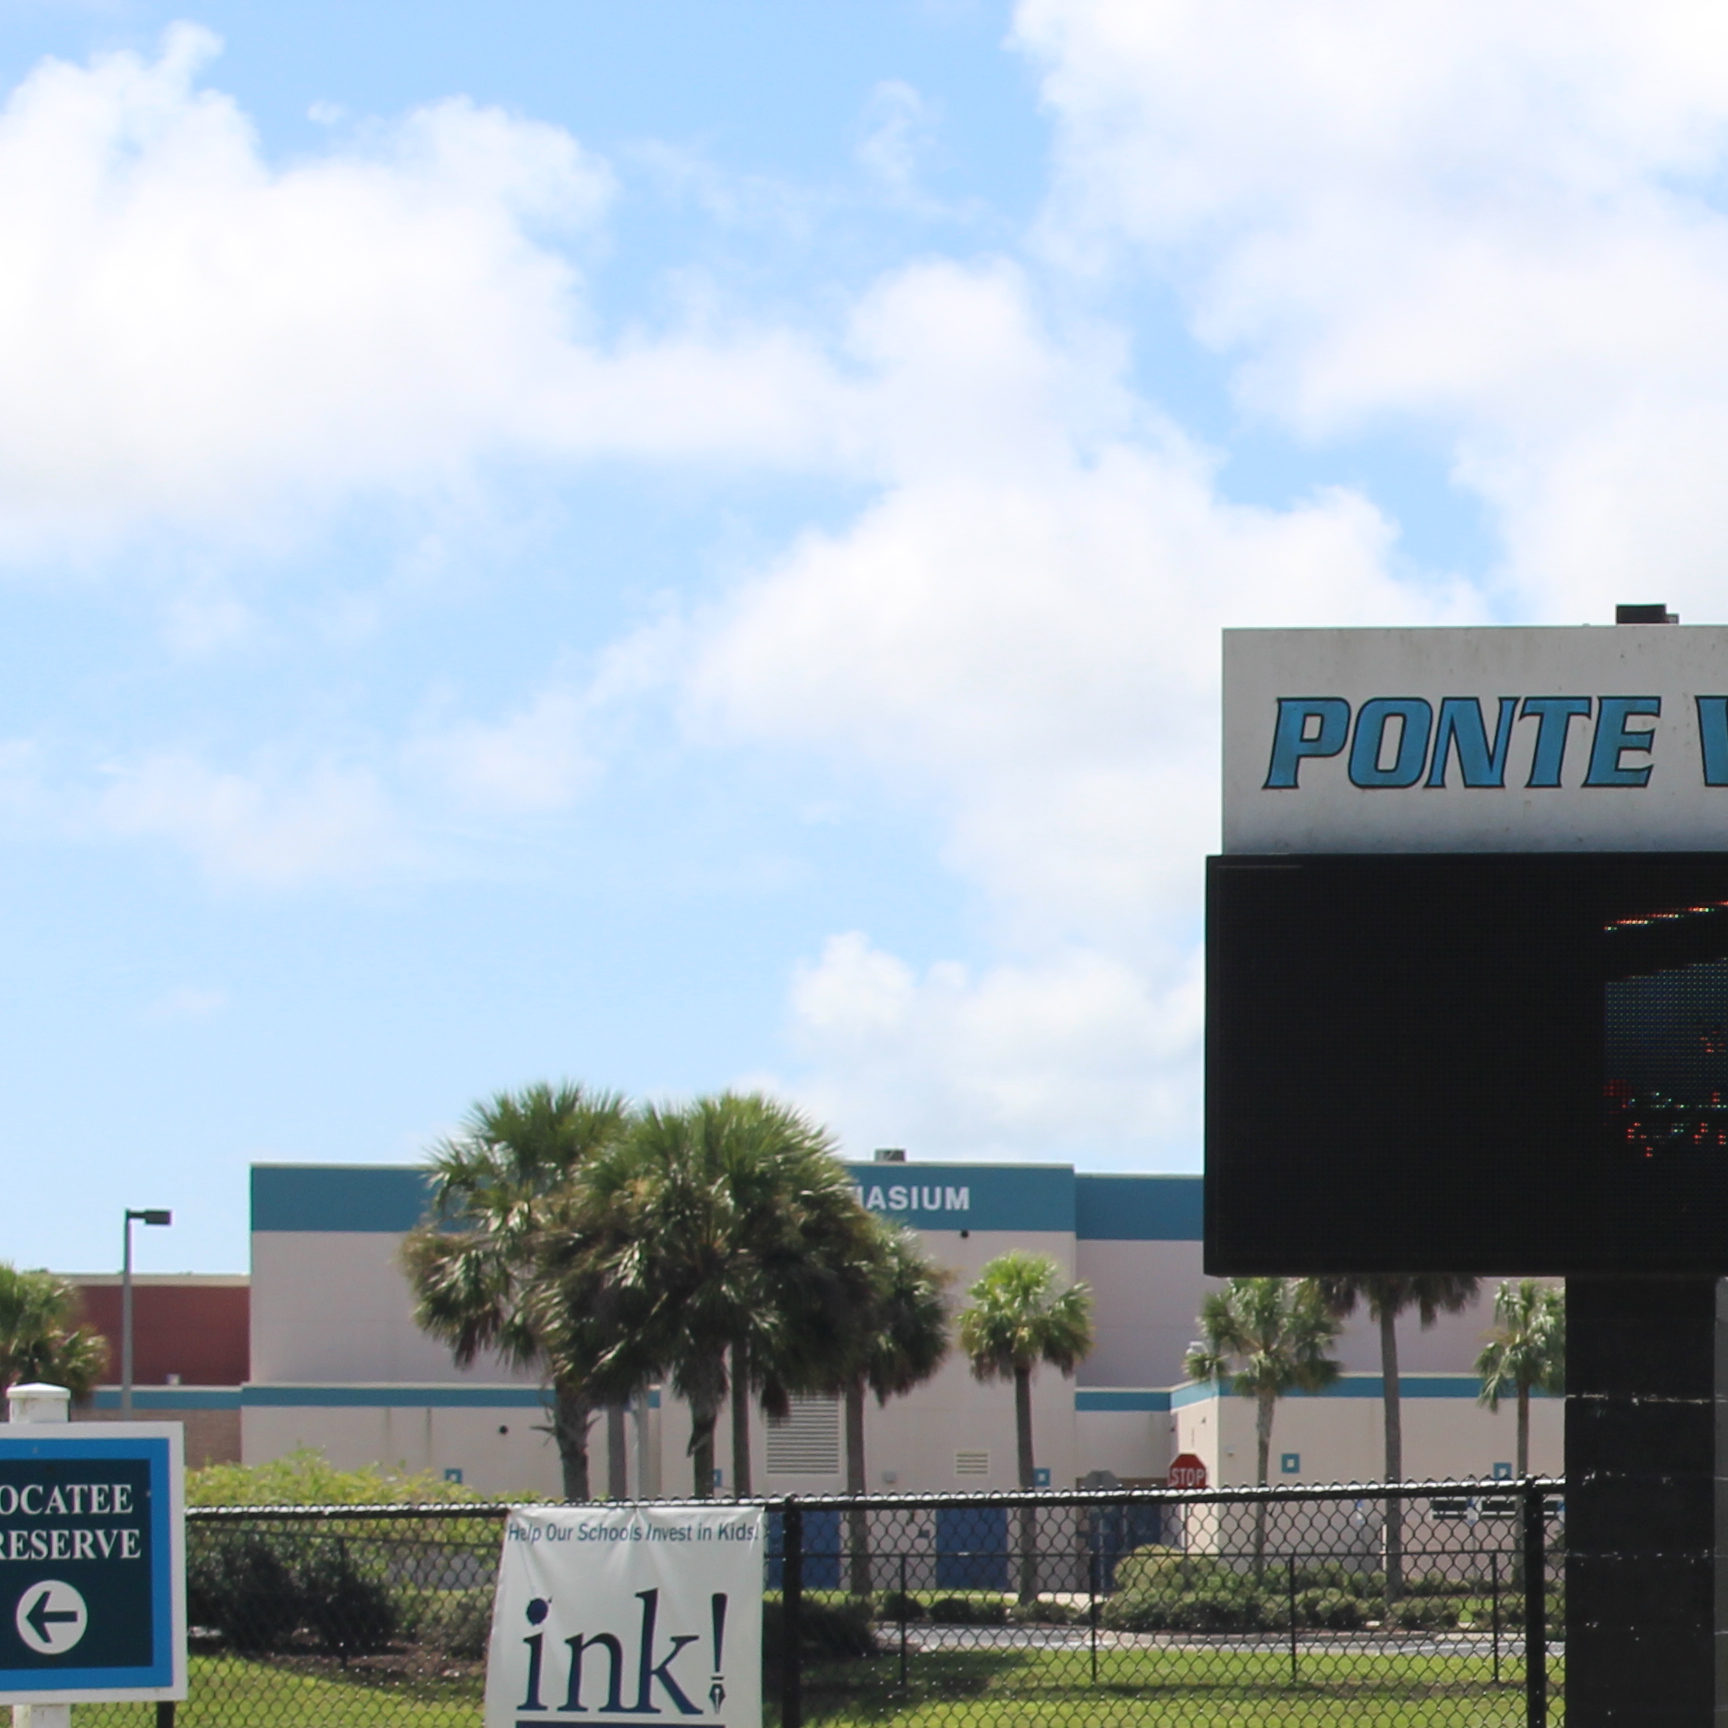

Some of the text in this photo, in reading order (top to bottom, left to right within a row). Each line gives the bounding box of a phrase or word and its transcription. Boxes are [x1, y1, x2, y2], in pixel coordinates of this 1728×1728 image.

[1262, 695, 1662, 790] PONTE
[1169, 1467, 1205, 1487] STOP
[508, 1522, 760, 1545] Help Our Schools Invest in Kids!
[516, 1587, 728, 1715] ink!
